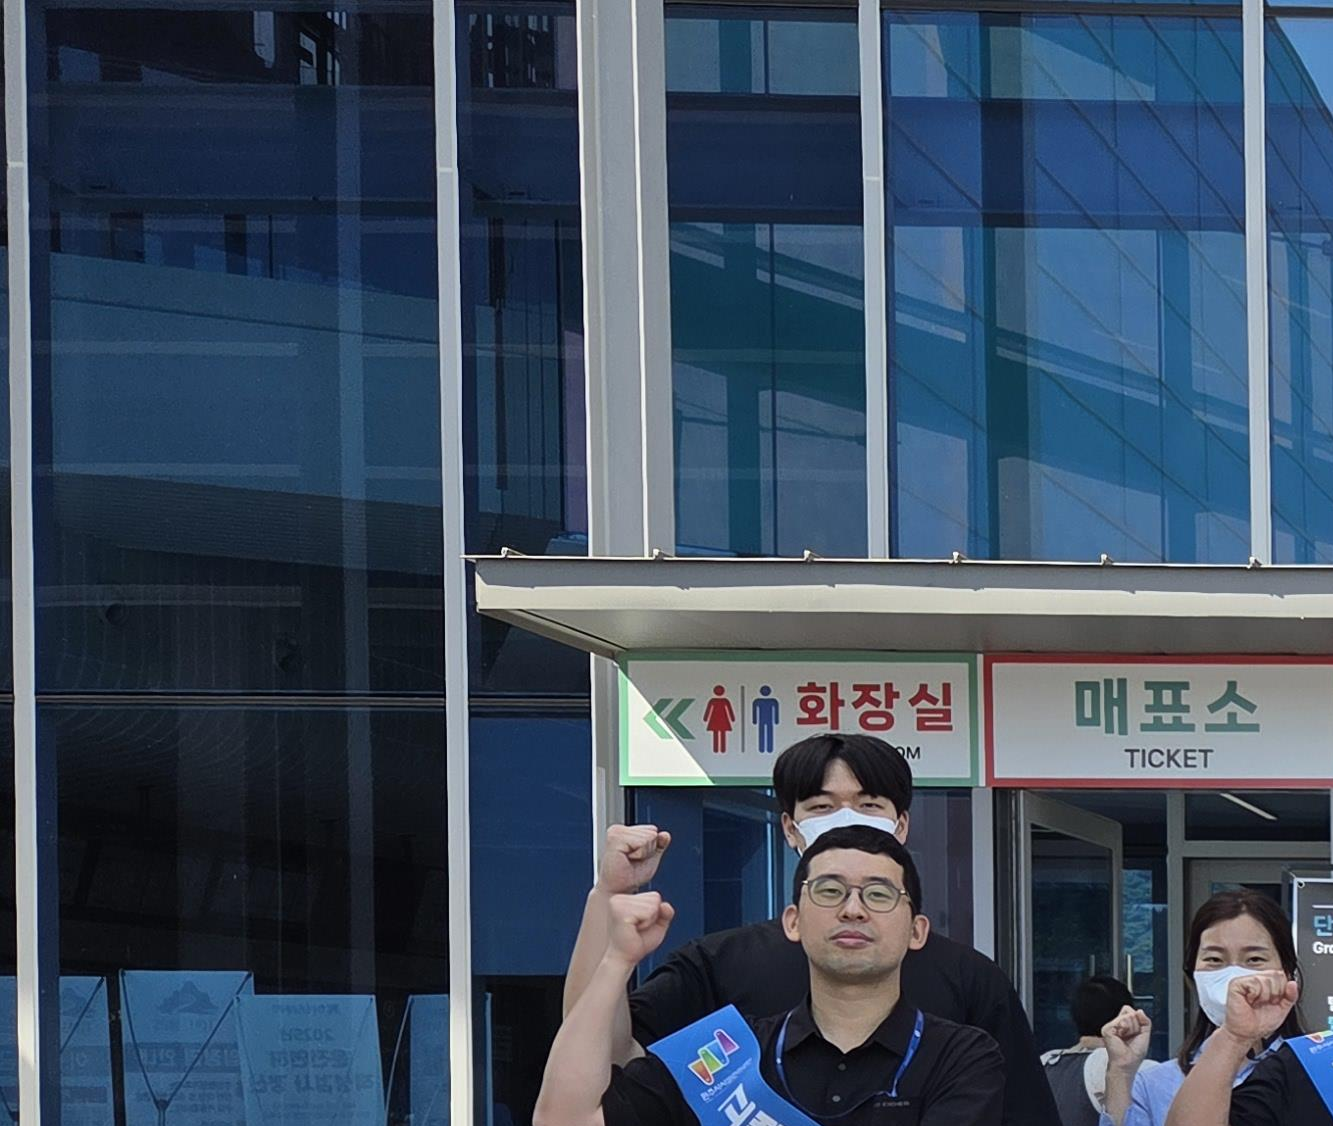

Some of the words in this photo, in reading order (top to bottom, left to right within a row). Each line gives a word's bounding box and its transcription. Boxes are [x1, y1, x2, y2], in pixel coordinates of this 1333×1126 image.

[797, 682, 953, 731] 화장실
[1075, 678, 1260, 736] 매표소
[1124, 749, 1214, 768] TICKET
